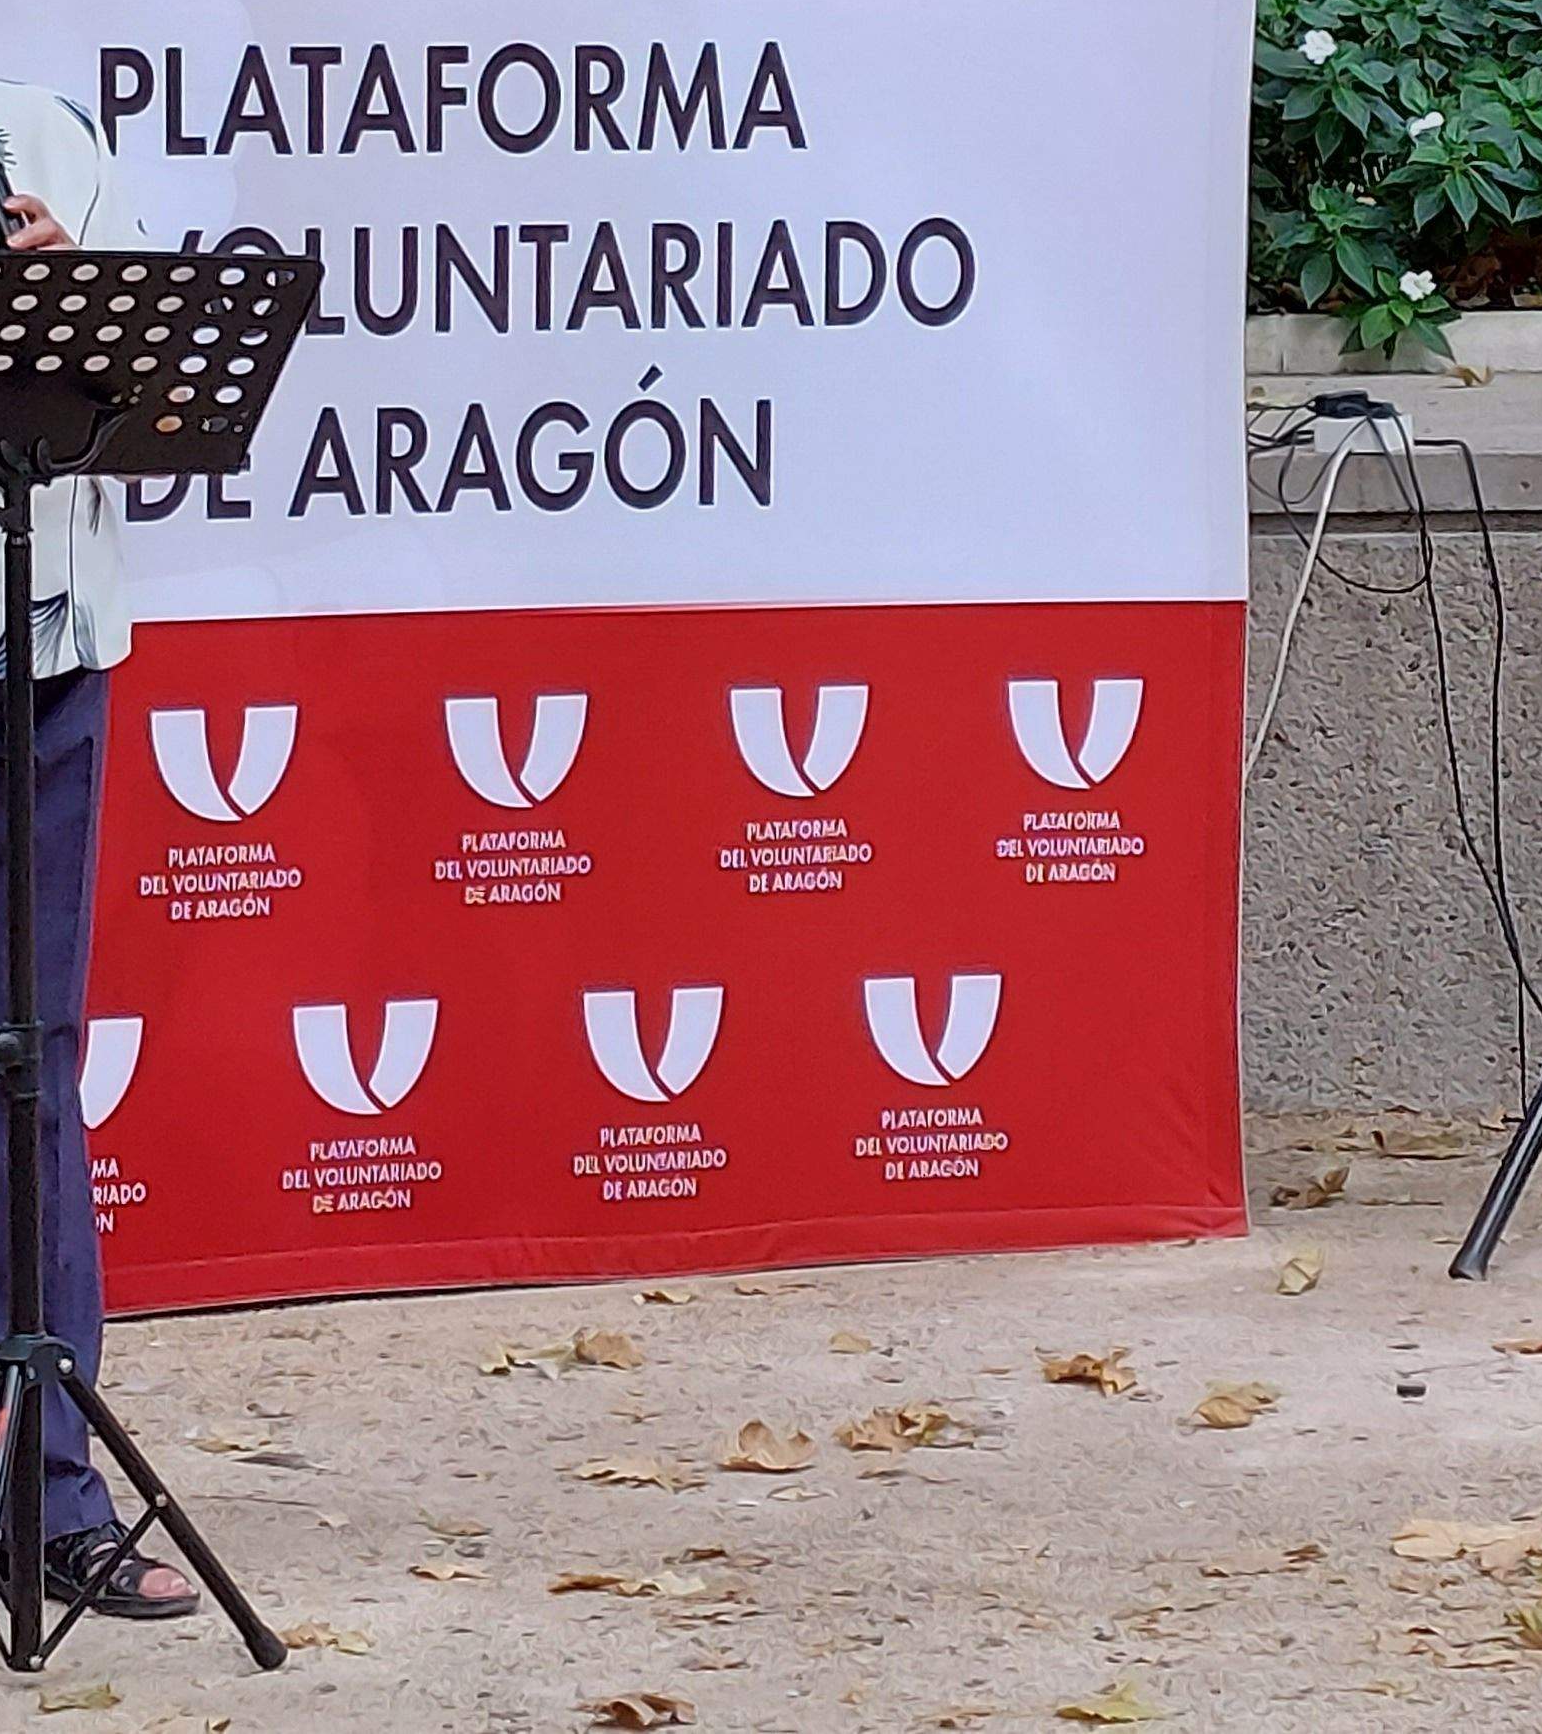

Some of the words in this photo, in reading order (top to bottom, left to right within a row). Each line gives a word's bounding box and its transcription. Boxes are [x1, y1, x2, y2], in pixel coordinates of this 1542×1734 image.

[99, 40, 808, 157] PLATAFORMA
[137, 215, 976, 338] LUNTARIADO
[286, 363, 773, 519] ARAGÓN
[745, 817, 849, 844] PLATAFORMA
[1022, 809, 1122, 833] PLATAFORMA
[167, 841, 278, 870] PLATAFORMA
[460, 828, 568, 855] PLATAFORMA
[995, 837, 1026, 859] DEL
[1024, 835, 1146, 859] VOLUNTARIADO
[433, 859, 464, 881] DEL
[464, 853, 593, 880] VOLUNTARIADO
[719, 847, 750, 870] DEL
[748, 842, 874, 868] VOLUNTARIADO
[1024, 861, 1046, 884] DE
[1046, 856, 1117, 883] ARAGÓN
[139, 874, 170, 897] DEL
[170, 865, 303, 896] VOLUNTARIADO
[486, 877, 562, 905] ARAGÓN
[747, 871, 770, 895] DE
[770, 865, 844, 893] ARAGÓN
[169, 899, 194, 922] DE
[194, 890, 271, 921] ARAGÓN
[880, 1106, 985, 1132] PLATAFORMA
[308, 1134, 418, 1163] PLATAFORMA
[599, 1122, 703, 1149] PLATAFORMA
[854, 1135, 884, 1158] DEL
[884, 1130, 1010, 1156] VOLUNTARIADO
[602, 1147, 728, 1175] VOLUNTARIADO
[883, 1159, 906, 1181] DE
[907, 1154, 980, 1180] ARAGÓN
[281, 1167, 312, 1191] DEL
[312, 1160, 443, 1190] VOLUNTARIADO
[601, 1178, 624, 1202] DE
[625, 1172, 698, 1200] ARAGÓN
[335, 1184, 412, 1212] ARAGÓN
